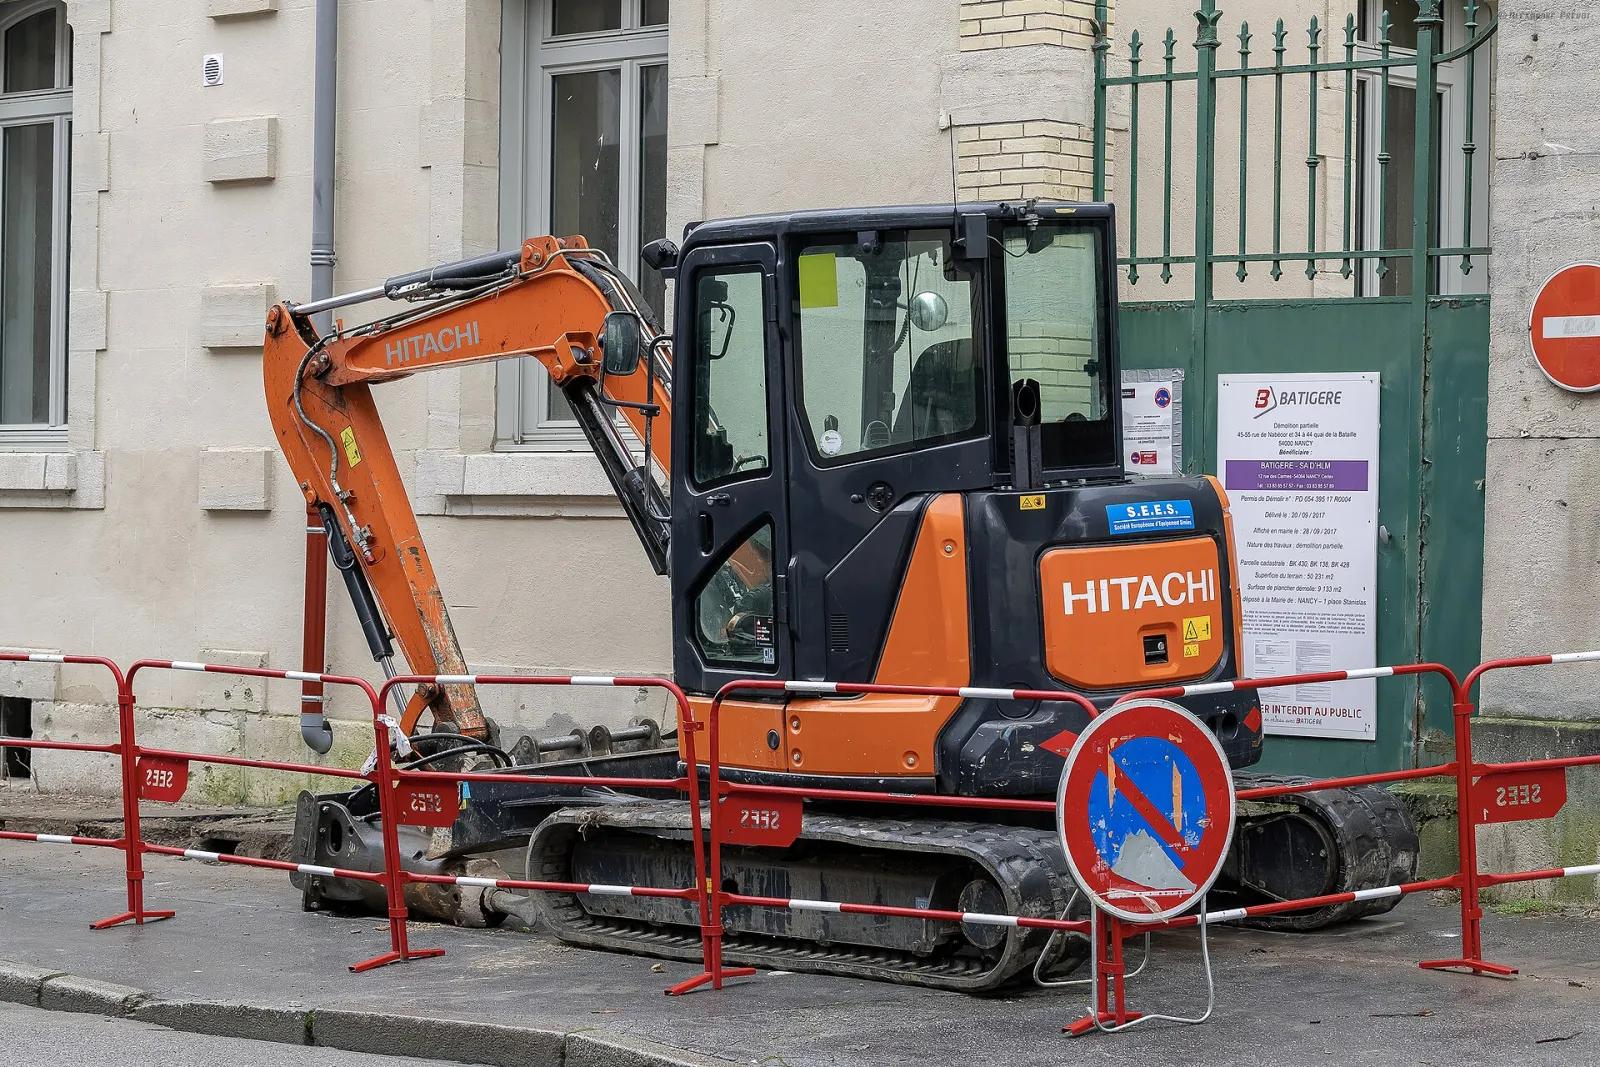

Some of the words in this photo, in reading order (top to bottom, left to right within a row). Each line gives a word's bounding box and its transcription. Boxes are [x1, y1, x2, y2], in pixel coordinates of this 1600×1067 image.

[385, 321, 480, 366] HITACHI
[1280, 391, 1342, 406] BATIGERE
[1126, 504, 1178, 518] S.E.E.S.
[1062, 568, 1214, 616] HITACHI
[1272, 705, 1312, 716] INTERDIT
[1315, 708, 1328, 716] AU
[1330, 708, 1362, 718] PUBLIC
